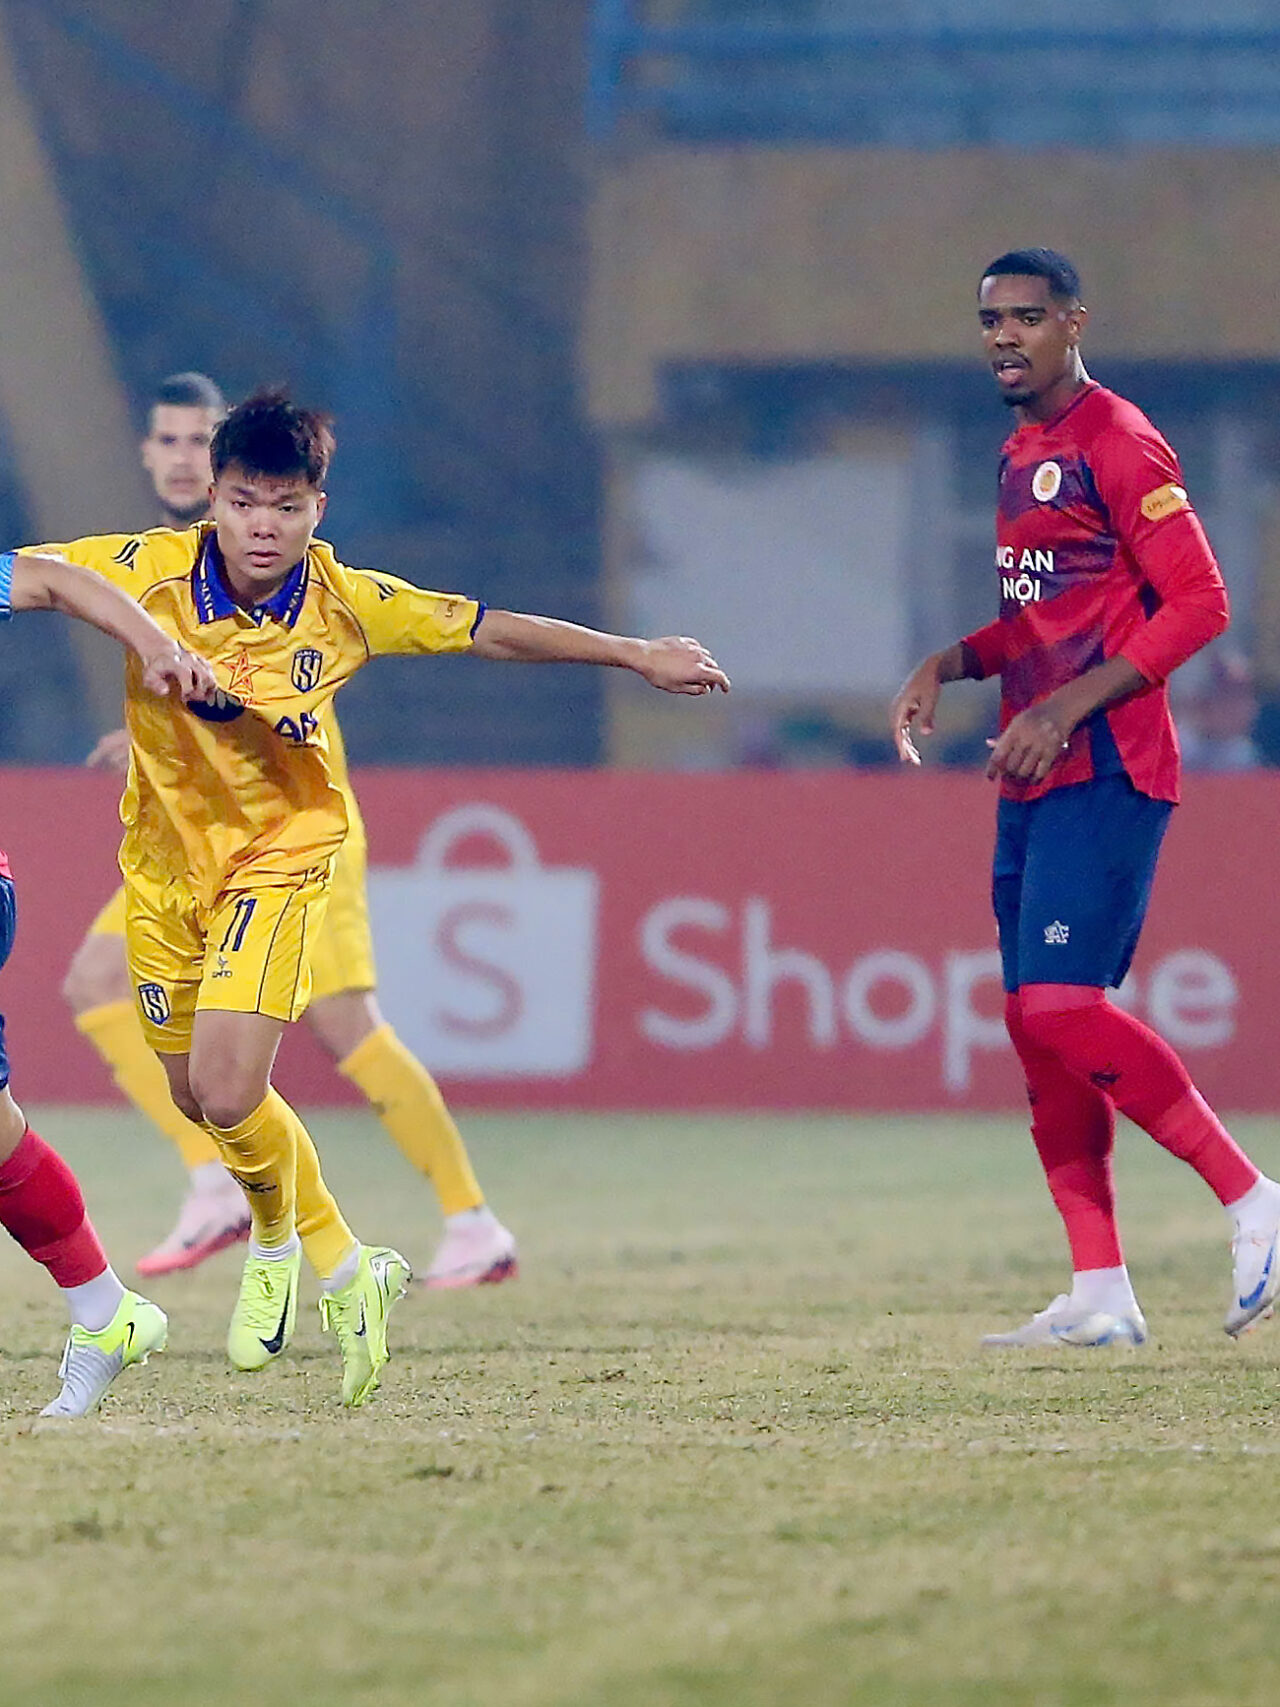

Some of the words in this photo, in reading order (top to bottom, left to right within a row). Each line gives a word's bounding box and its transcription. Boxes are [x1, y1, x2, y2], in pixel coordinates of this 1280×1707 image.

[1019, 548, 1054, 572] AN
[1002, 573, 1041, 606] NỘI
[219, 898, 257, 952] 11
[434, 899, 523, 1041] S
[639, 896, 1236, 1091] Shope
